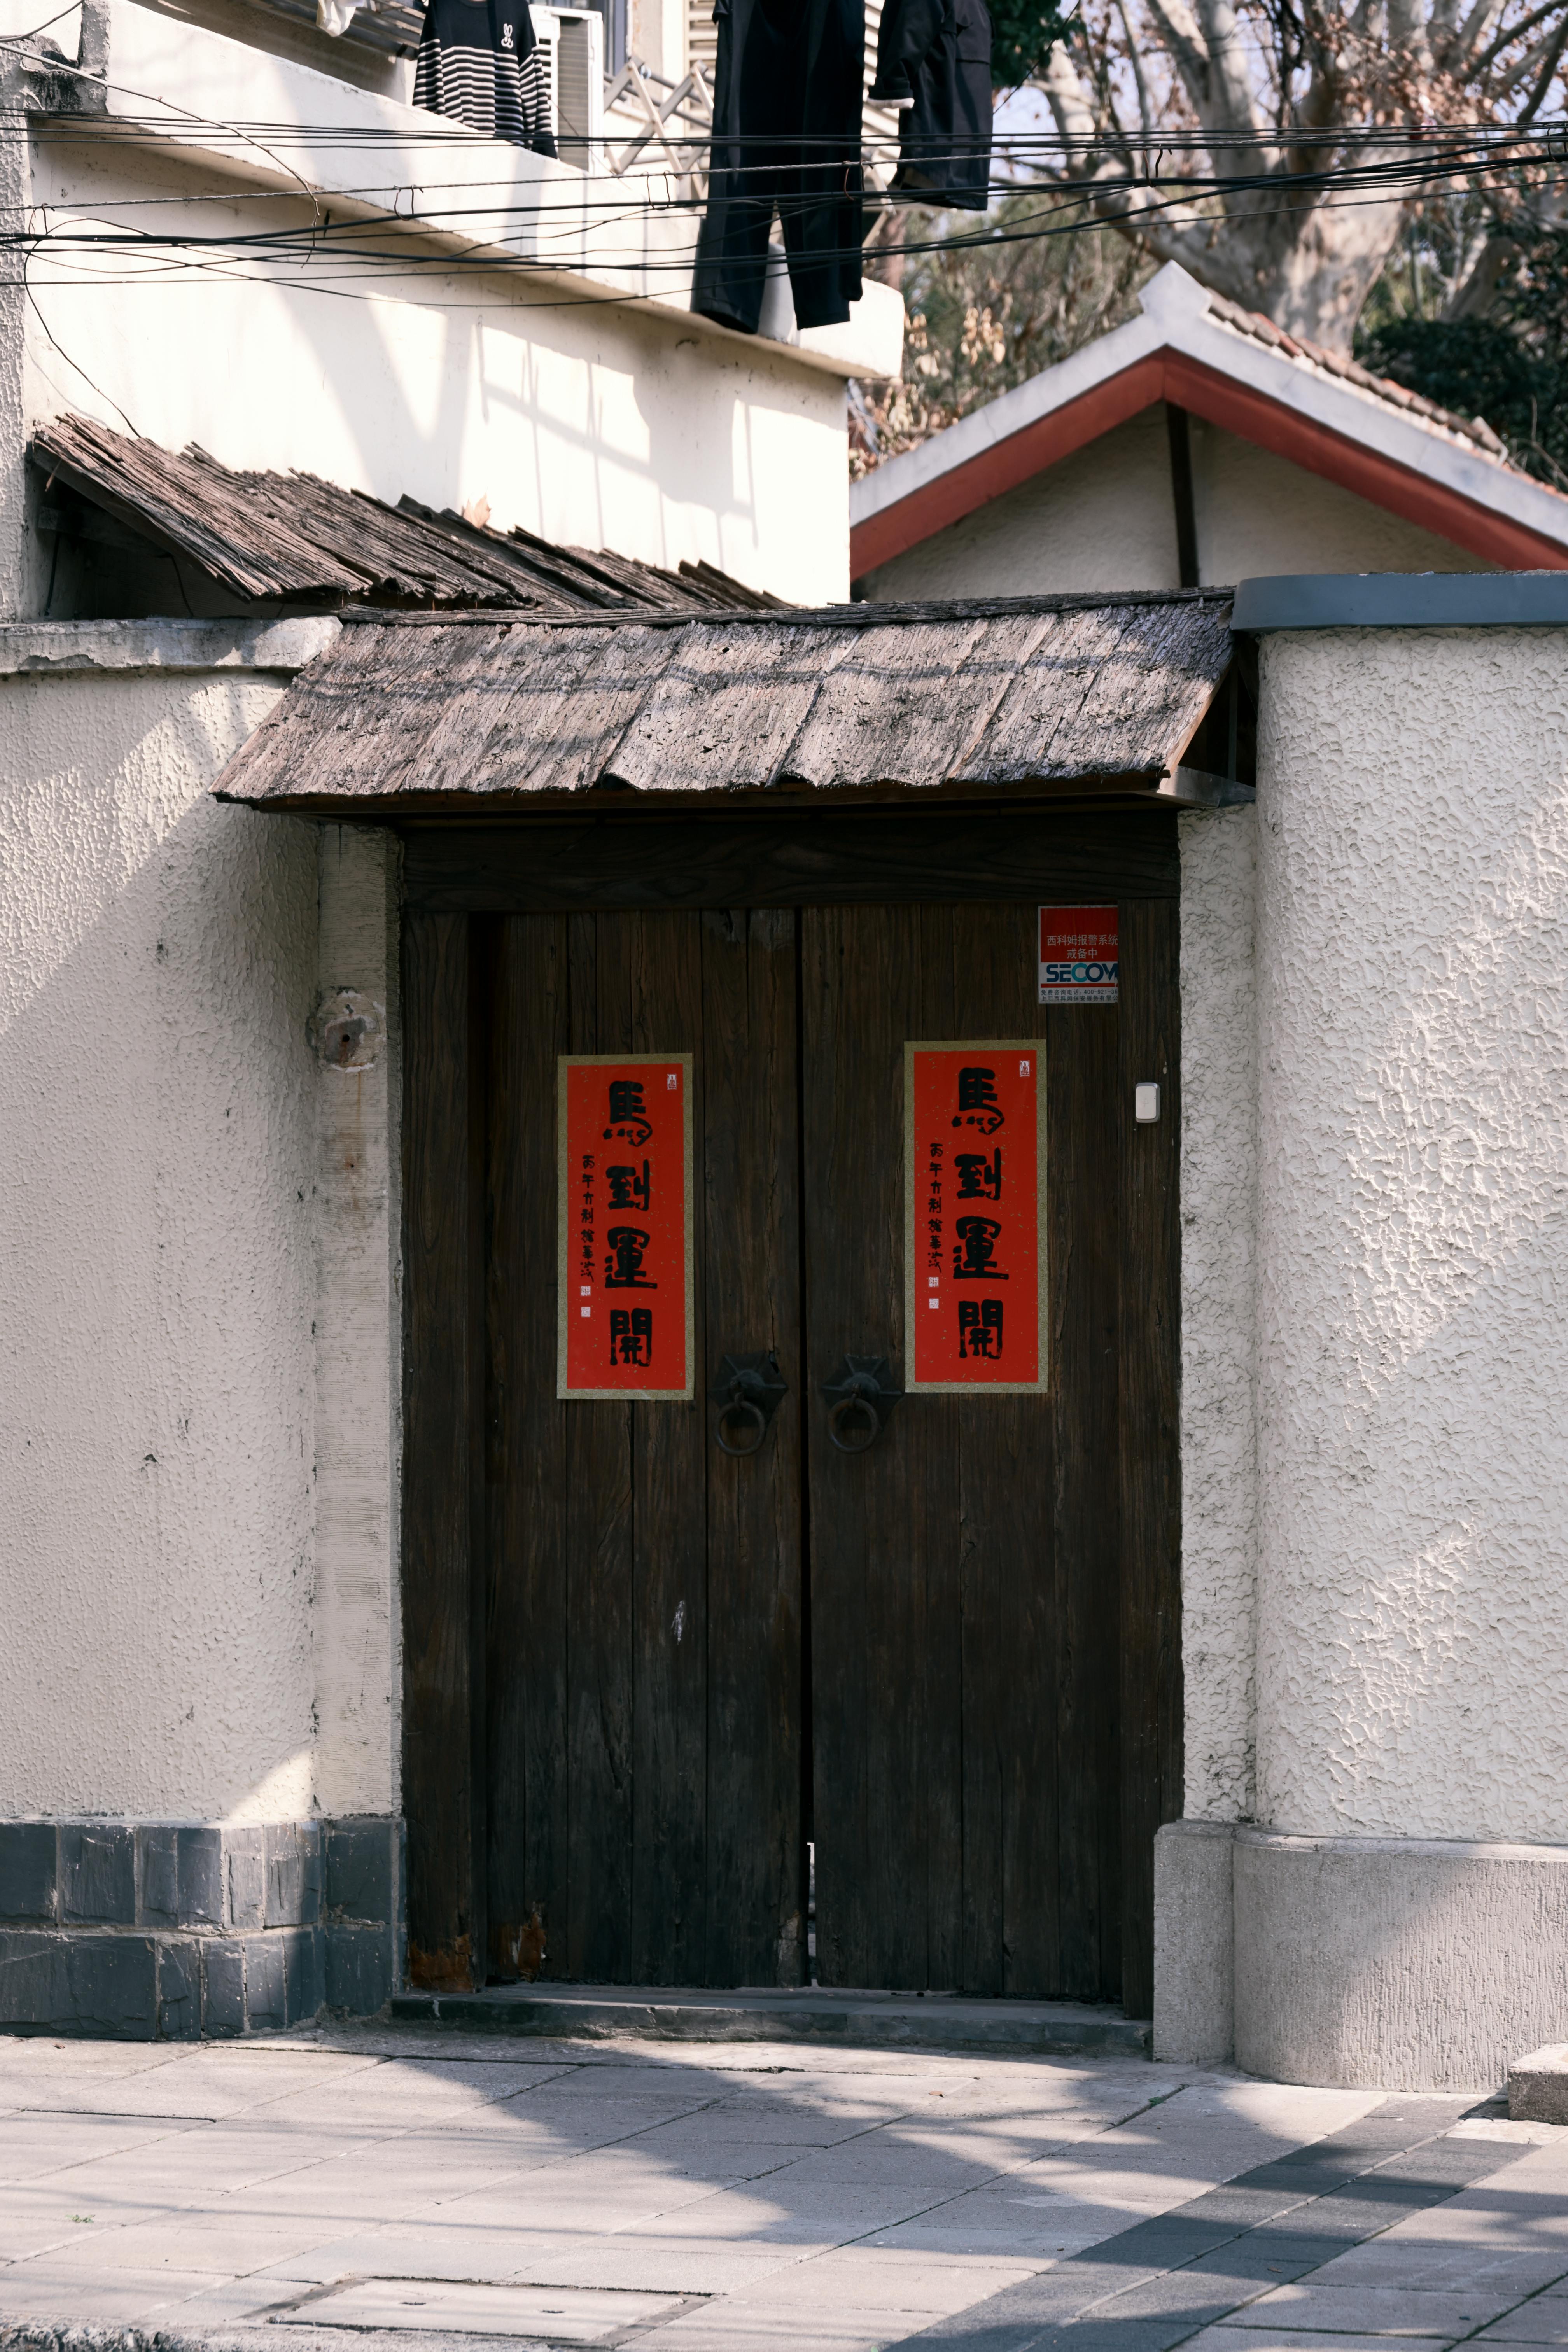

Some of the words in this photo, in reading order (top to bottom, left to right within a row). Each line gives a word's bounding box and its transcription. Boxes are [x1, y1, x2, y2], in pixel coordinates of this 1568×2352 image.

[1047, 934, 1118, 946] 西科姆报警系统
[1067, 947, 1097, 959] 戒备中
[603, 1080, 658, 1367] 馬到運開
[951, 1067, 1009, 1360] 馬到運開
